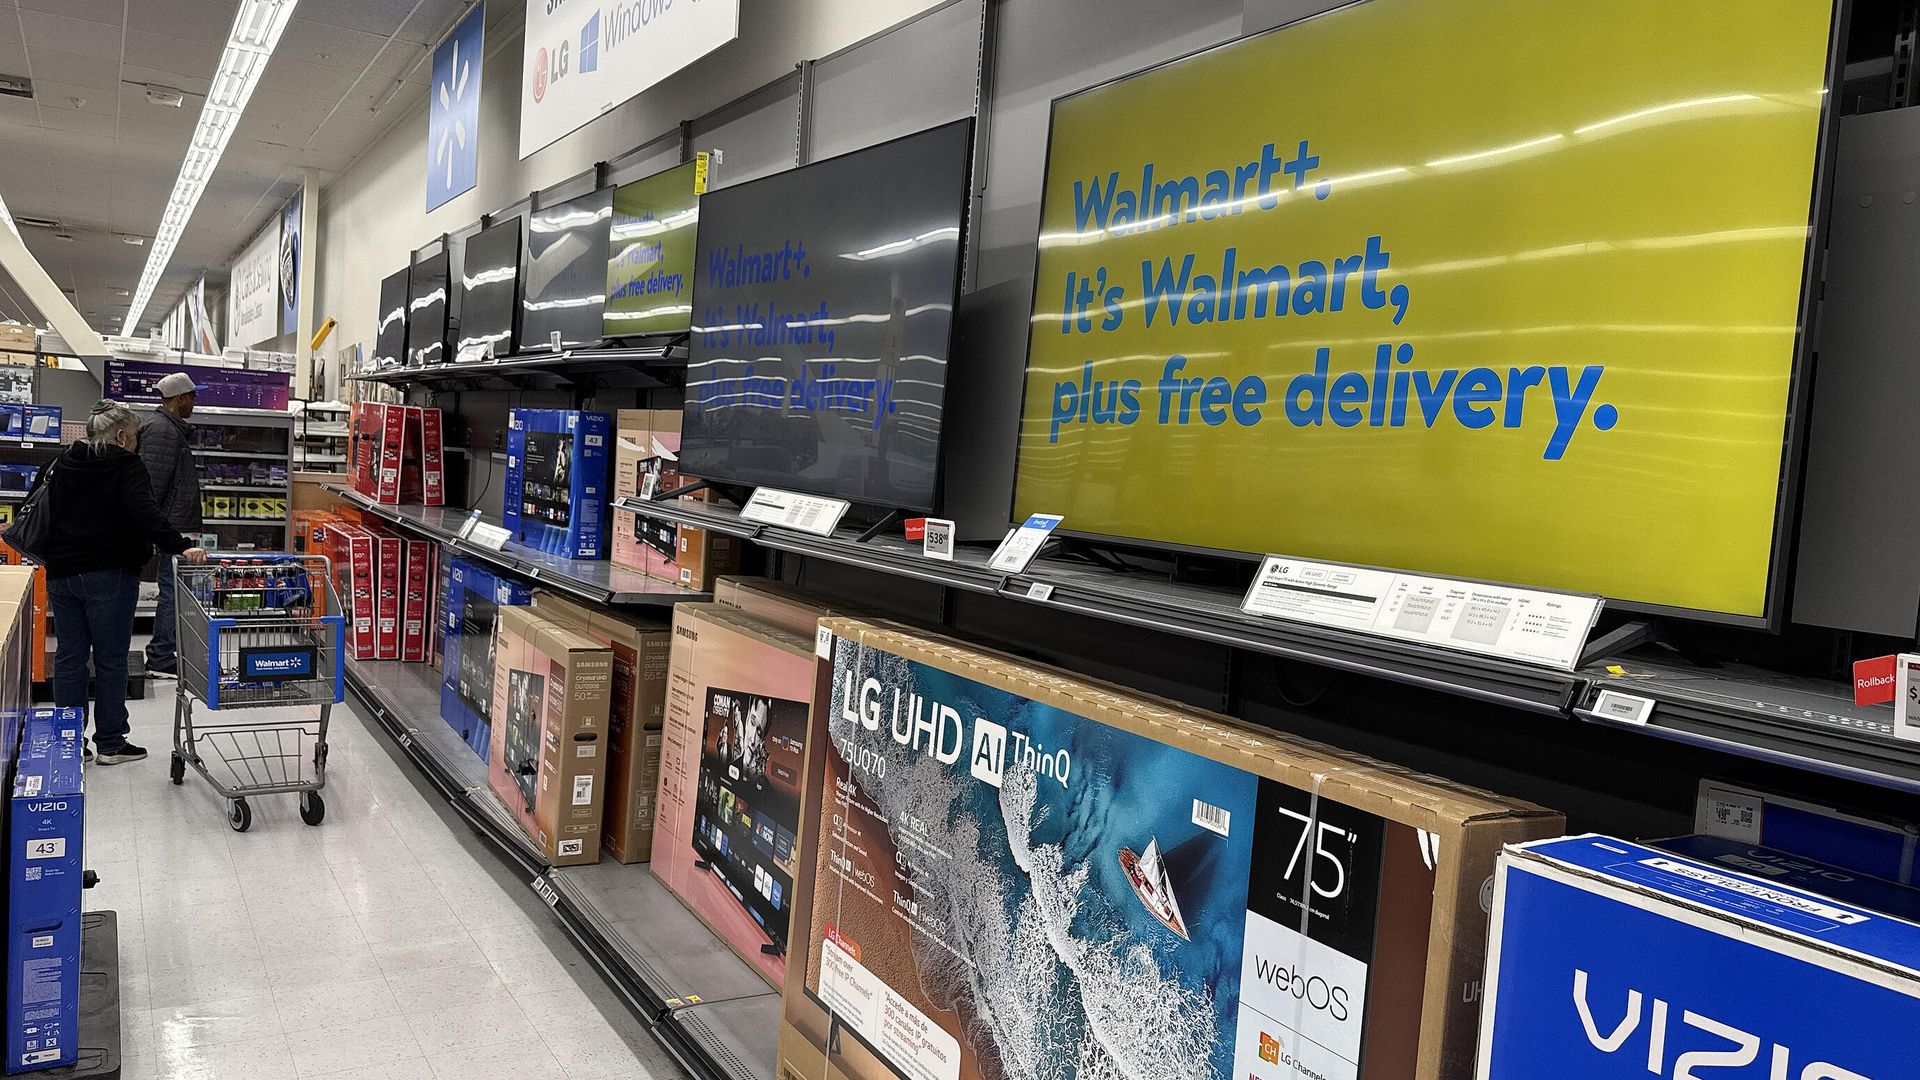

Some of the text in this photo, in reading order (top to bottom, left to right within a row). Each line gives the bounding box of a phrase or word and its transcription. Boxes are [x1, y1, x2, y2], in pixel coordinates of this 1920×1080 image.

[550, 39, 569, 84] LG
[1073, 140, 1331, 240] Walmart+.
[708, 240, 811, 290] Walmart+.
[628, 274, 645, 296] free
[646, 269, 684, 298] delivery.
[1060, 235, 1411, 335] It's Walmart,
[736, 302, 835, 353] Walmart,
[742, 364, 786, 408] free
[790, 363, 896, 431] delivery.
[1049, 342, 1620, 460] plus free delivery.
[1279, 566, 1289, 574] LG
[676, 625, 699, 642] SAMSUNG
[255, 659, 289, 668] Walmart
[1858, 674, 1895, 689] Rollback
[842, 669, 1071, 789] LG UHD AI ThinQ
[840, 737, 886, 779] 75UQ70
[28, 801, 67, 812] VIZIO
[899, 811, 929, 838] 4K REAL
[1279, 806, 1358, 899] 75"
[893, 889, 911, 914] ThinQ
[829, 928, 836, 940] LG
[1255, 954, 1349, 1021] webOS
[1463, 980, 1483, 1003] UH
[884, 1019, 893, 1031] por
[884, 1004, 947, 1064] 300 canales IP gratuitos
[921, 1021, 928, 1034] de
[1573, 968, 1873, 1080] VIZI
[1264, 1043, 1277, 1057] CH
[1281, 1052, 1292, 1066] LG
